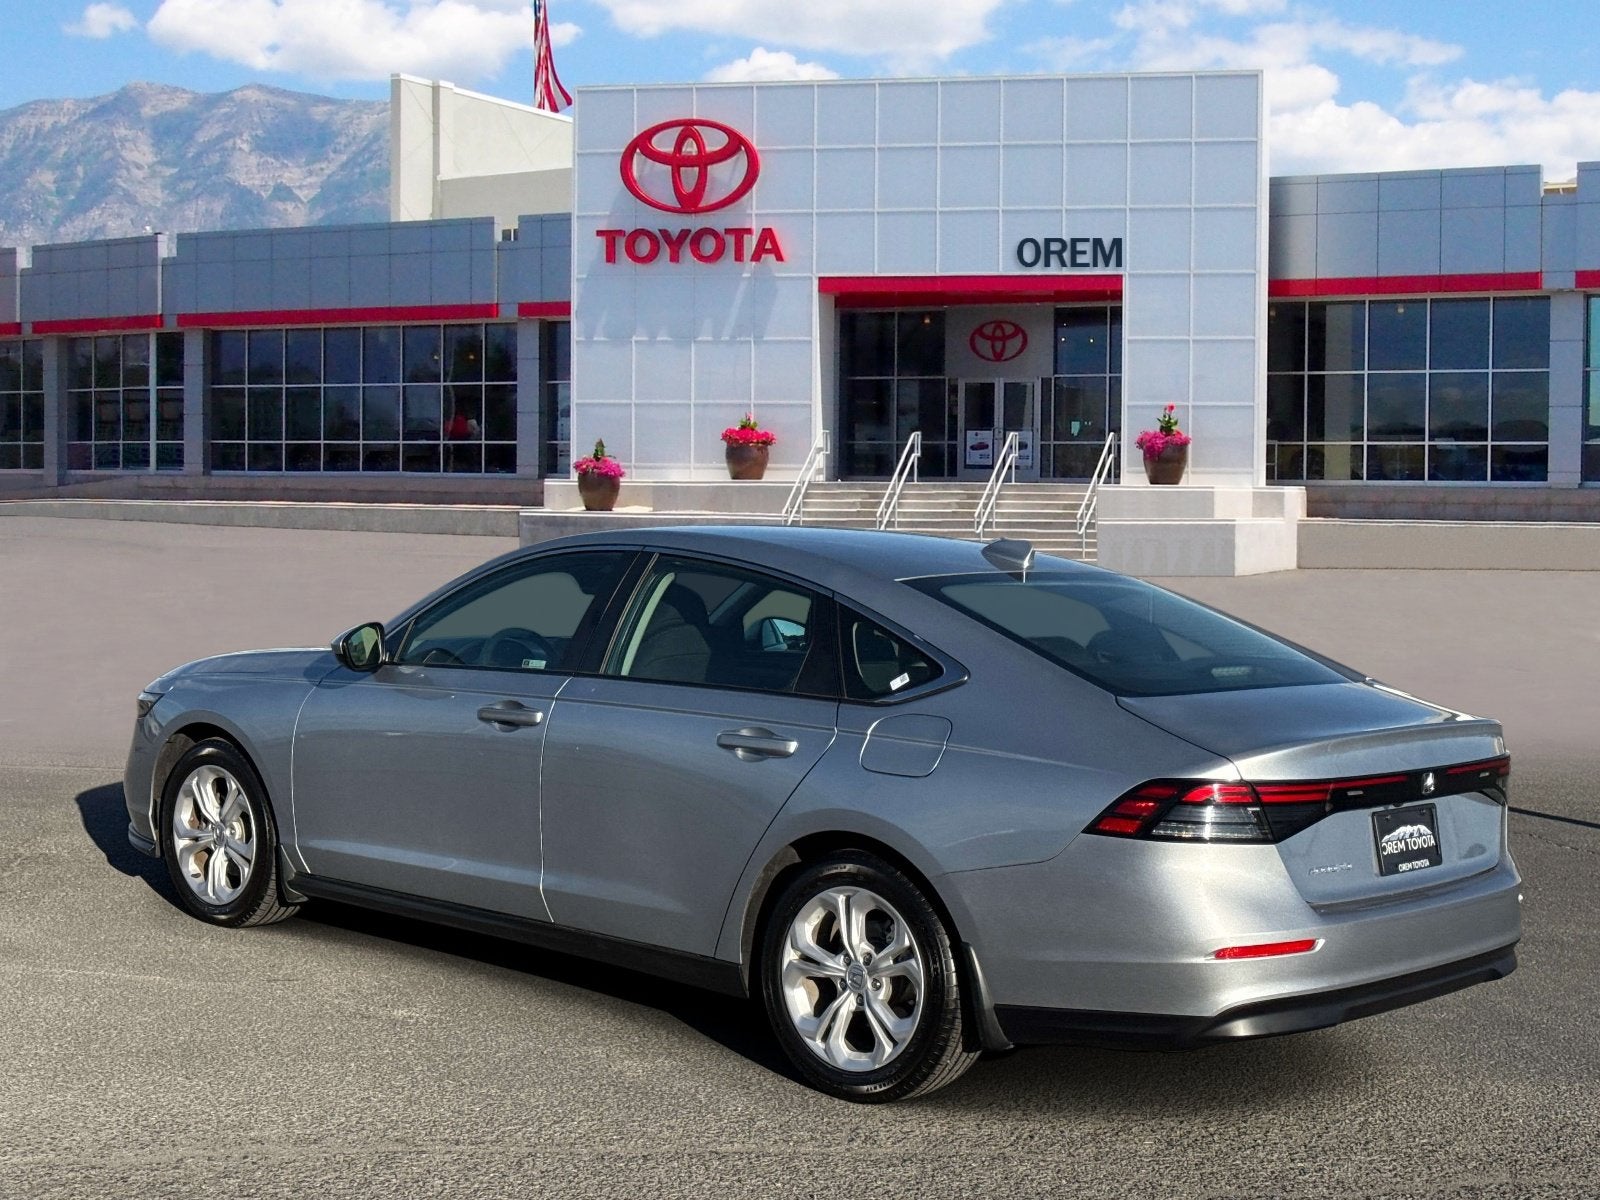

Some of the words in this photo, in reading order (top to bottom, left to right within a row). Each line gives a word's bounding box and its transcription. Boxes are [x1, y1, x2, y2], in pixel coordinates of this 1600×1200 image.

[596, 227, 785, 264] TOYOTA
[1017, 237, 1123, 268] OREM
[1381, 840, 1406, 855] OREM
[1406, 834, 1436, 851] TOYOTA
[1398, 862, 1412, 872] OREM
[1412, 858, 1430, 869] TOYOTA
